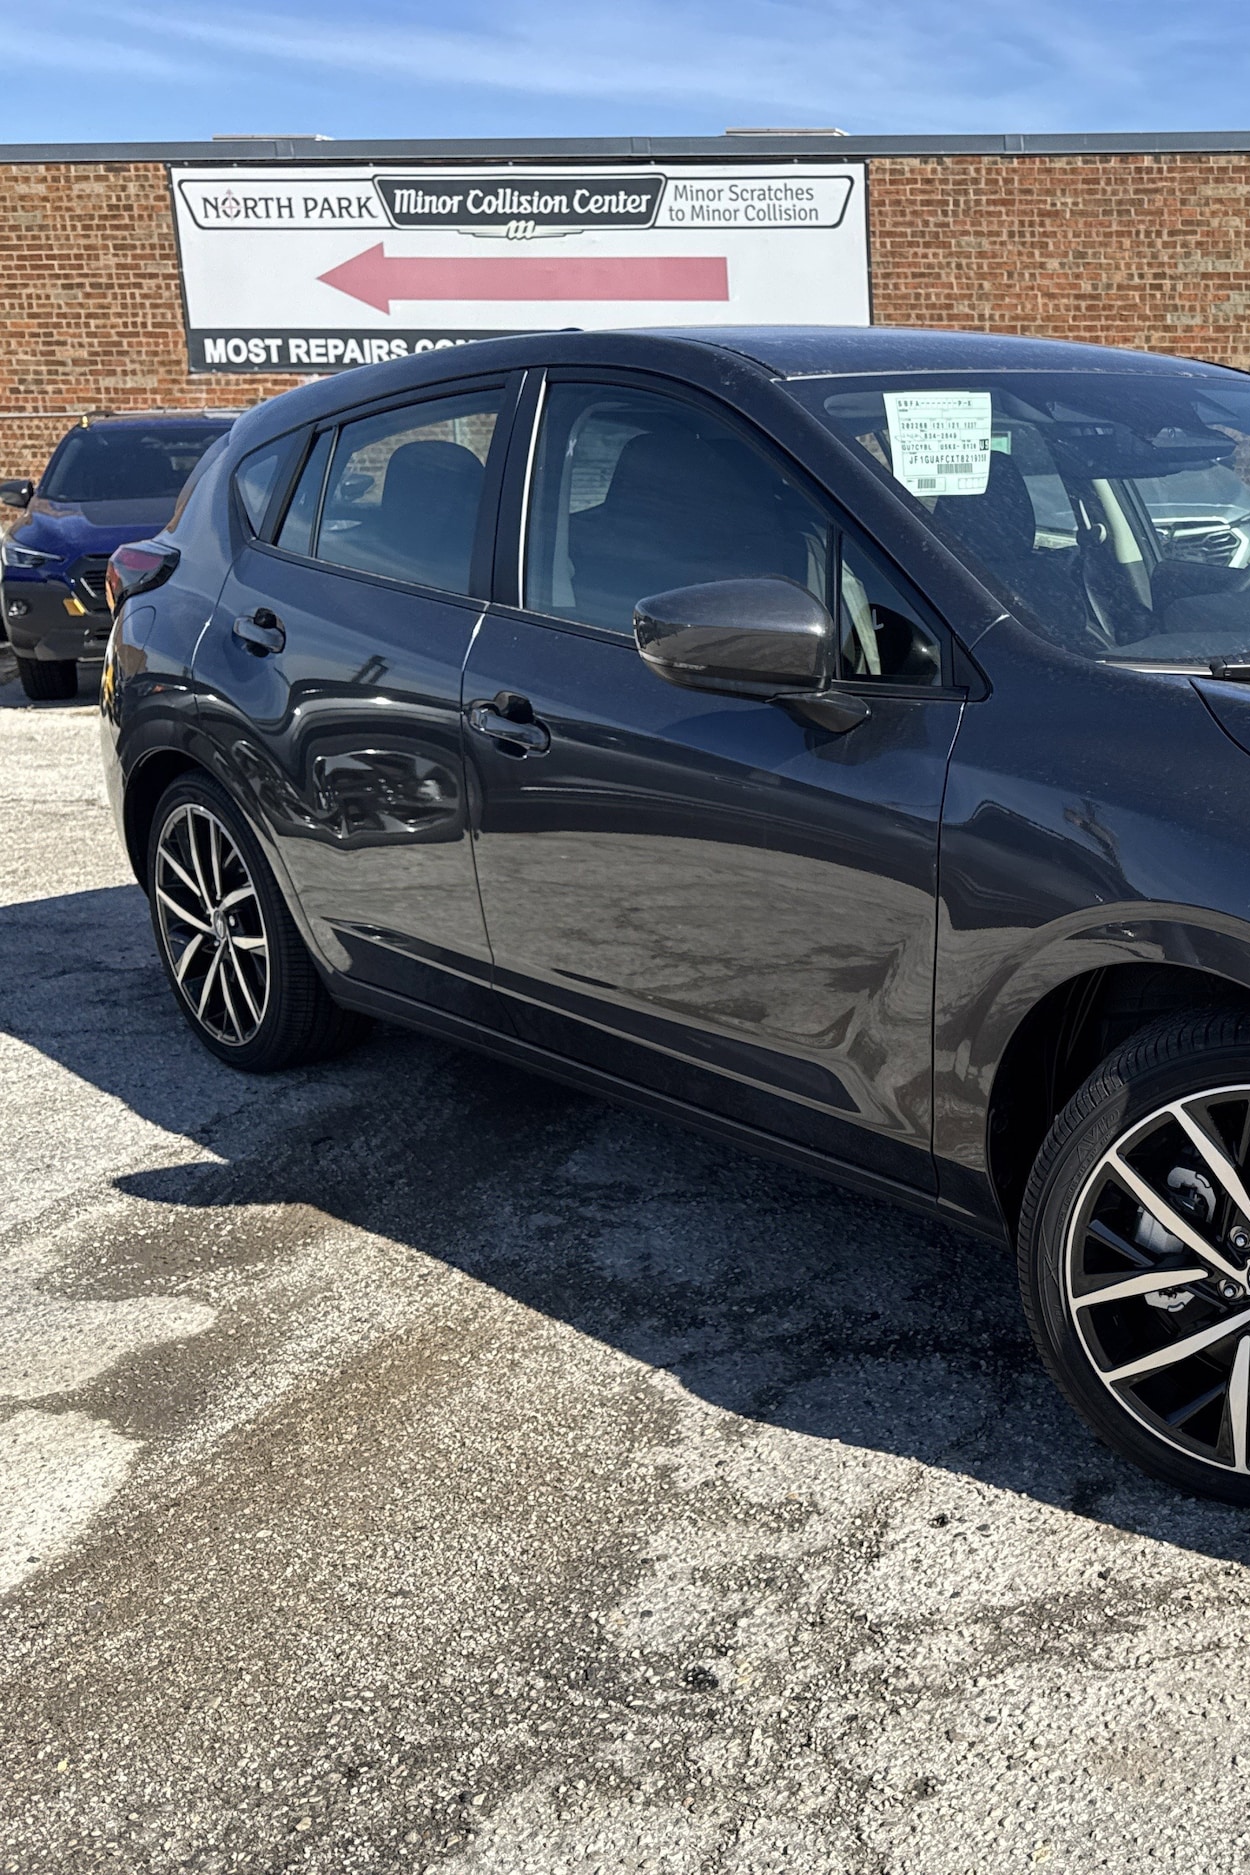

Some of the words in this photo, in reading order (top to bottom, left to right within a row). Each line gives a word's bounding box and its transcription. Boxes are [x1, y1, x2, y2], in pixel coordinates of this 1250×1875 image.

[393, 188, 463, 214] Minor
[466, 188, 570, 215] Collision
[573, 189, 652, 214] Center
[673, 185, 724, 201] Minor
[728, 184, 814, 201] Scratches
[201, 195, 295, 219] NORTH
[303, 195, 379, 219] PARK
[668, 206, 686, 221] to
[691, 204, 740, 222] Minor
[744, 204, 819, 222] Collision
[203, 337, 283, 364] MOST
[288, 338, 409, 364] REPAIRS
